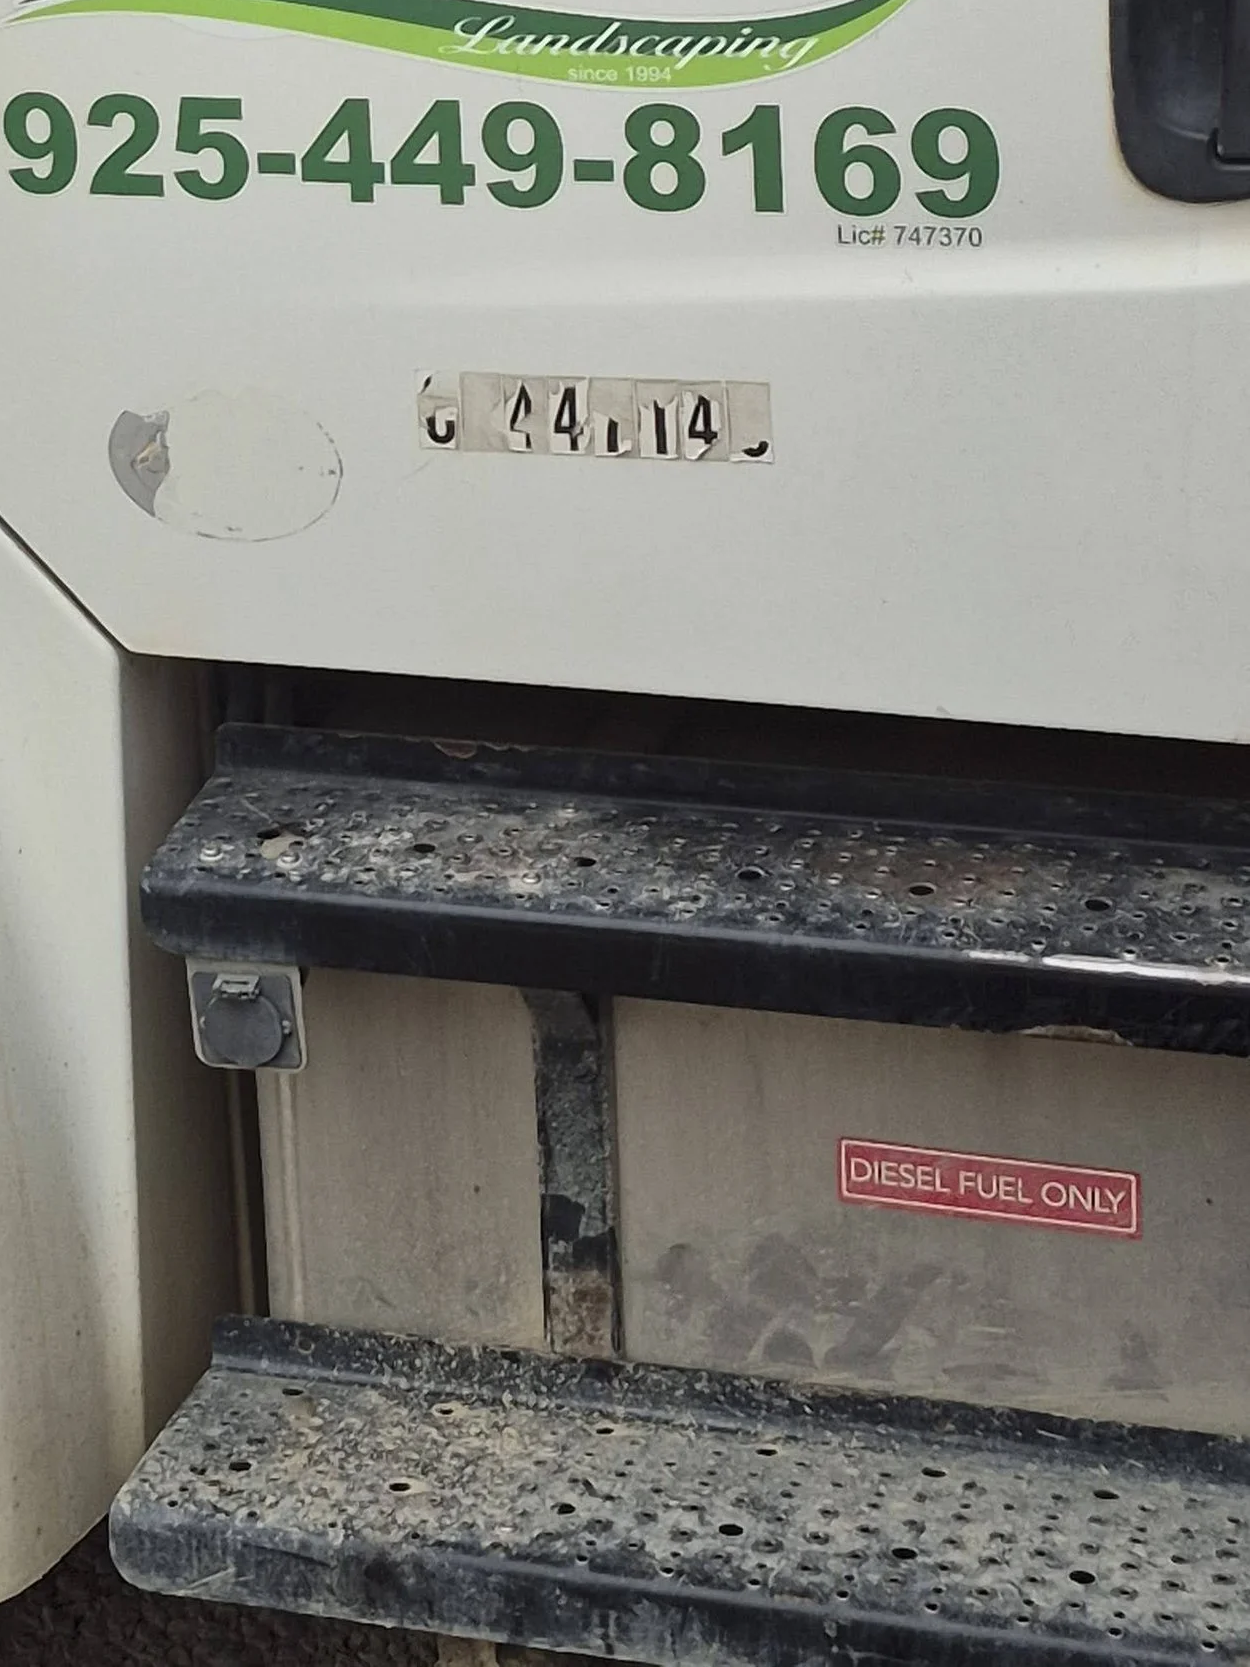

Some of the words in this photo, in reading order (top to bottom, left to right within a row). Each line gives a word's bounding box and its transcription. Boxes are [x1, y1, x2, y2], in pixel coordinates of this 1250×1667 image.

[439, 14, 820, 71] Landscaping
[567, 64, 618, 83] since
[626, 65, 673, 83] 1994
[3, 91, 1000, 217] 925-449-8169
[837, 224, 886, 245] Lic#
[894, 225, 983, 247] 747370
[850, 1157, 950, 1194] DIESEL
[958, 1170, 1033, 1205] FUEL
[1040, 1181, 1126, 1216] ONLY
